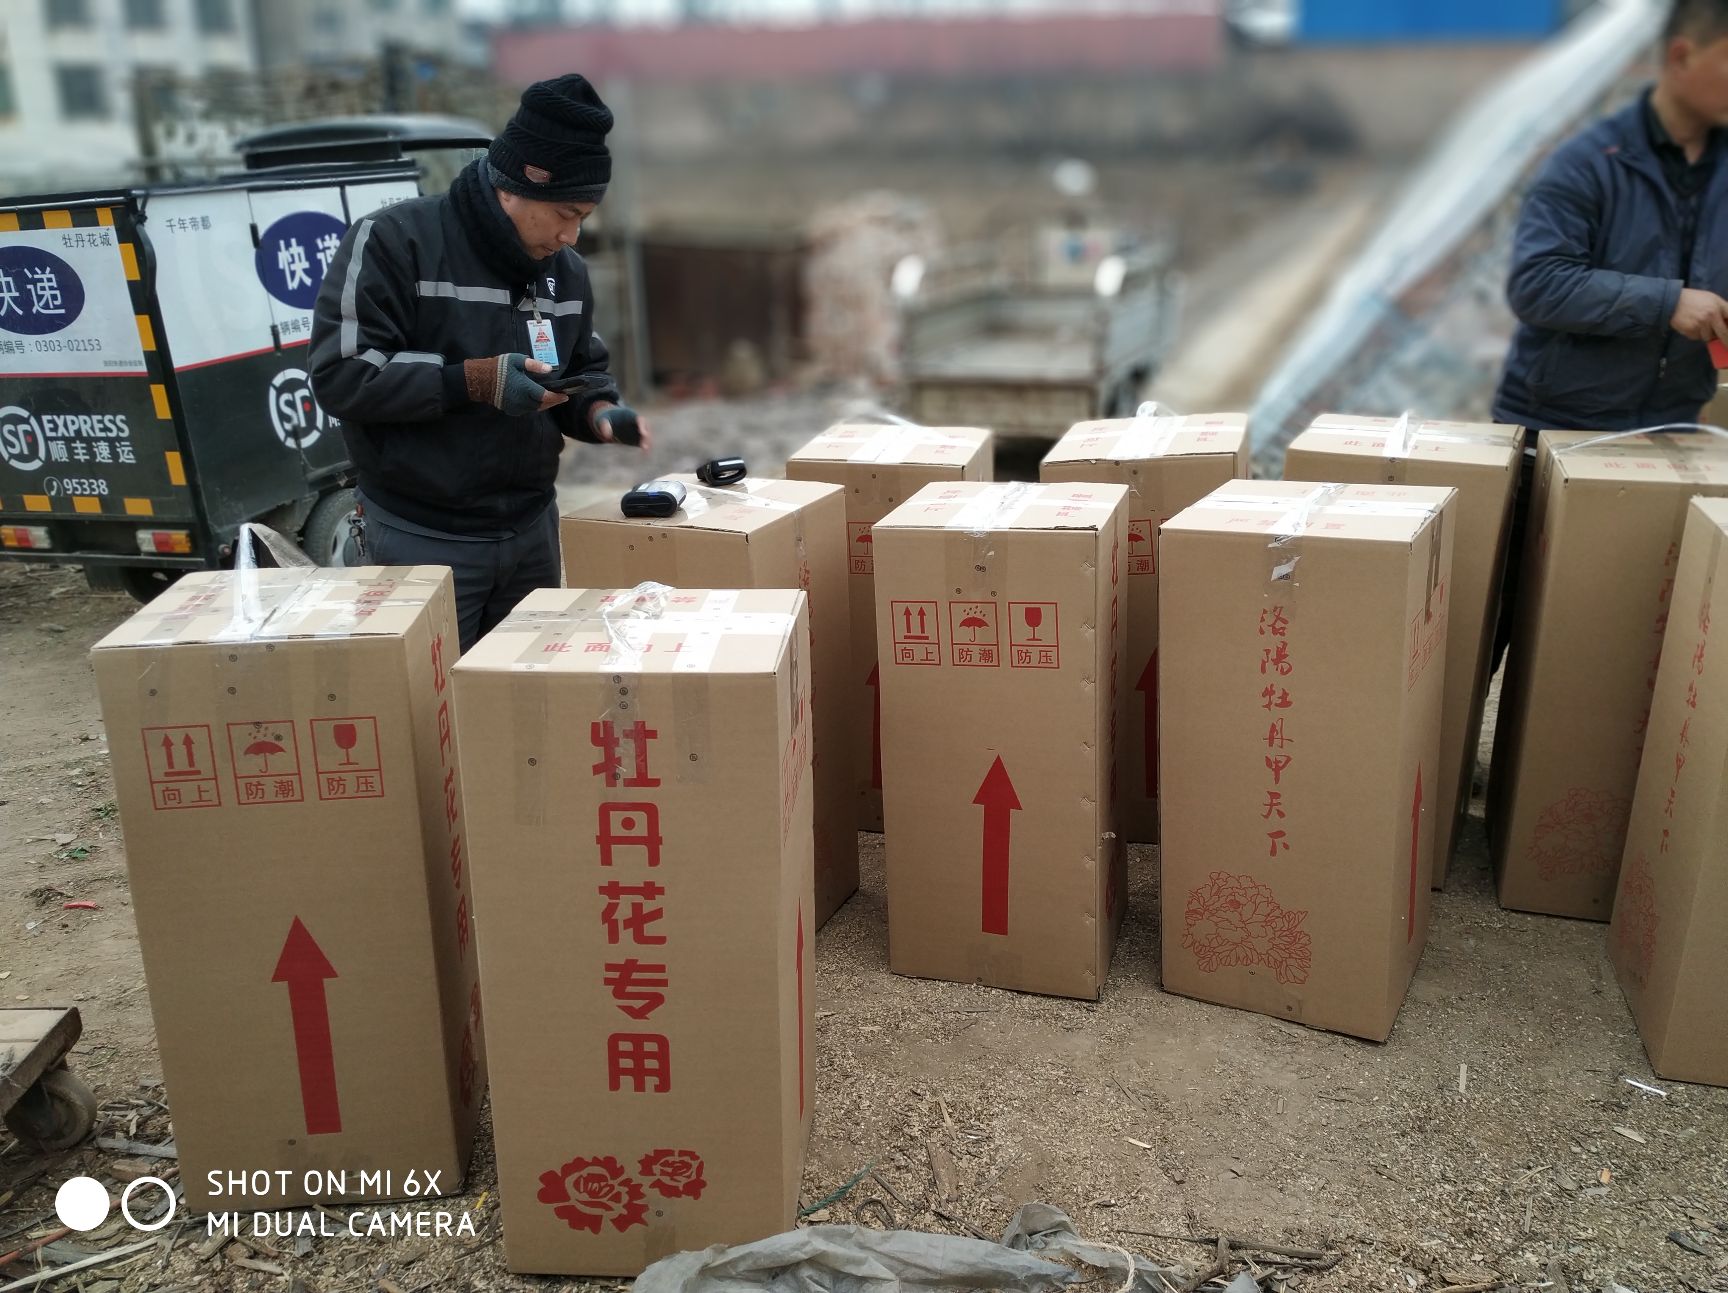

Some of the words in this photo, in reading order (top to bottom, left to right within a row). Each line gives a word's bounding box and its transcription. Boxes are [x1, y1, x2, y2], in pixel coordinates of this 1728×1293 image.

[165, 215, 211, 233] 千年帝都
[62, 232, 112, 248] 牡丹花城
[41, 415, 130, 437] EXPRESS
[48, 440, 136, 463] 顺丰速运
[63, 478, 109, 495] 95338
[901, 646, 936, 663] 向上
[958, 647, 994, 664] 防潮
[1017, 648, 1054, 665] 防压
[161, 781, 212, 806] 向上
[245, 778, 295, 801] 防潮
[326, 775, 376, 796] 防压
[431, 632, 469, 961] 牡丹花专用
[590, 720, 671, 1093] 牡丹花专用
